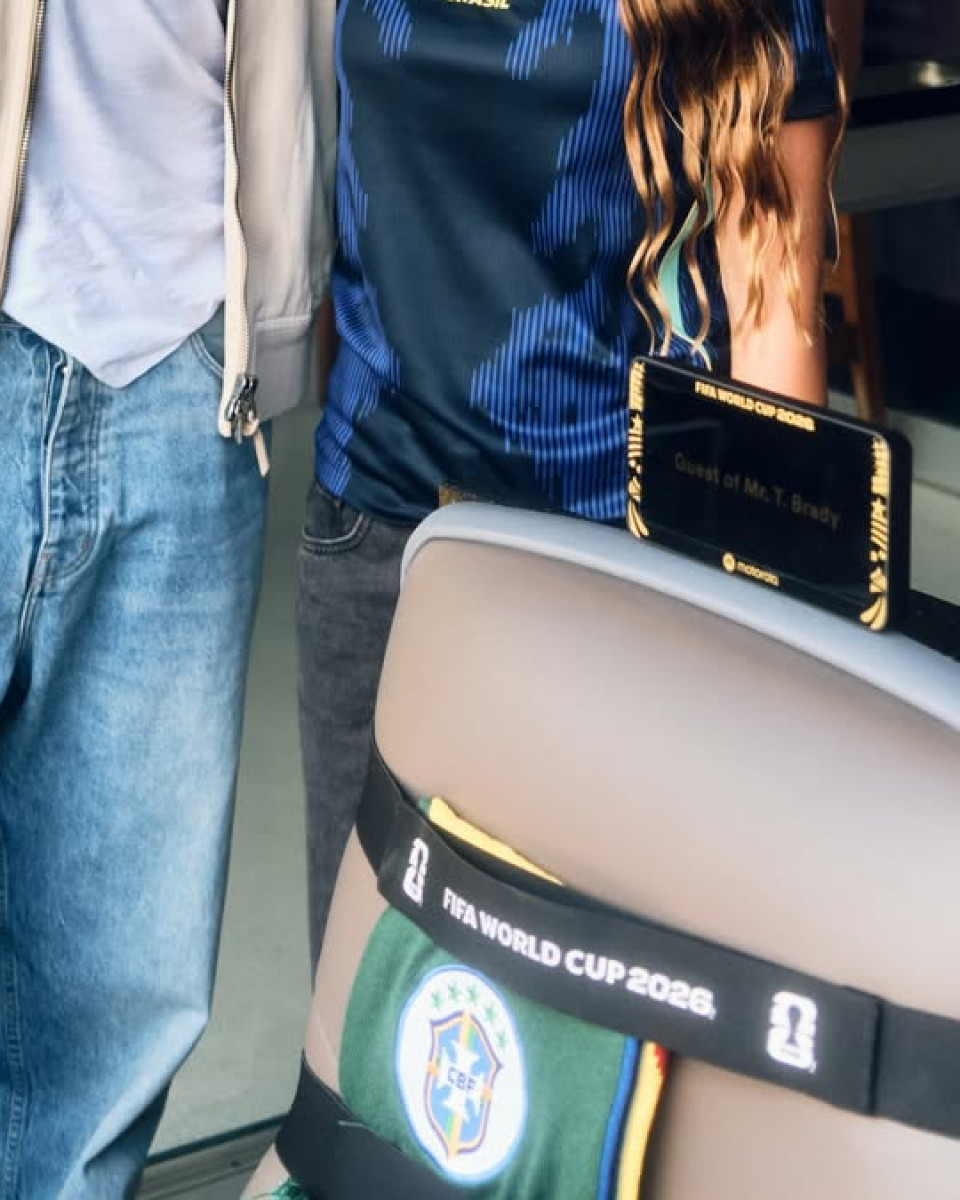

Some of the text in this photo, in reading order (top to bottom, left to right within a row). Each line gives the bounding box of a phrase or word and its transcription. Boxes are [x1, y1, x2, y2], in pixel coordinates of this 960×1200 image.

[694, 380, 717, 400] FIFA
[717, 388, 755, 412] WORLD
[754, 401, 776, 418] CUP
[675, 451, 720, 484] Guest
[723, 473, 741, 492] of
[744, 477, 770, 504] Mr.
[791, 493, 841, 531] Brady
[442, 887, 715, 1018] FIFA WORLD CUP 2026
[447, 1066, 476, 1093] CBF
